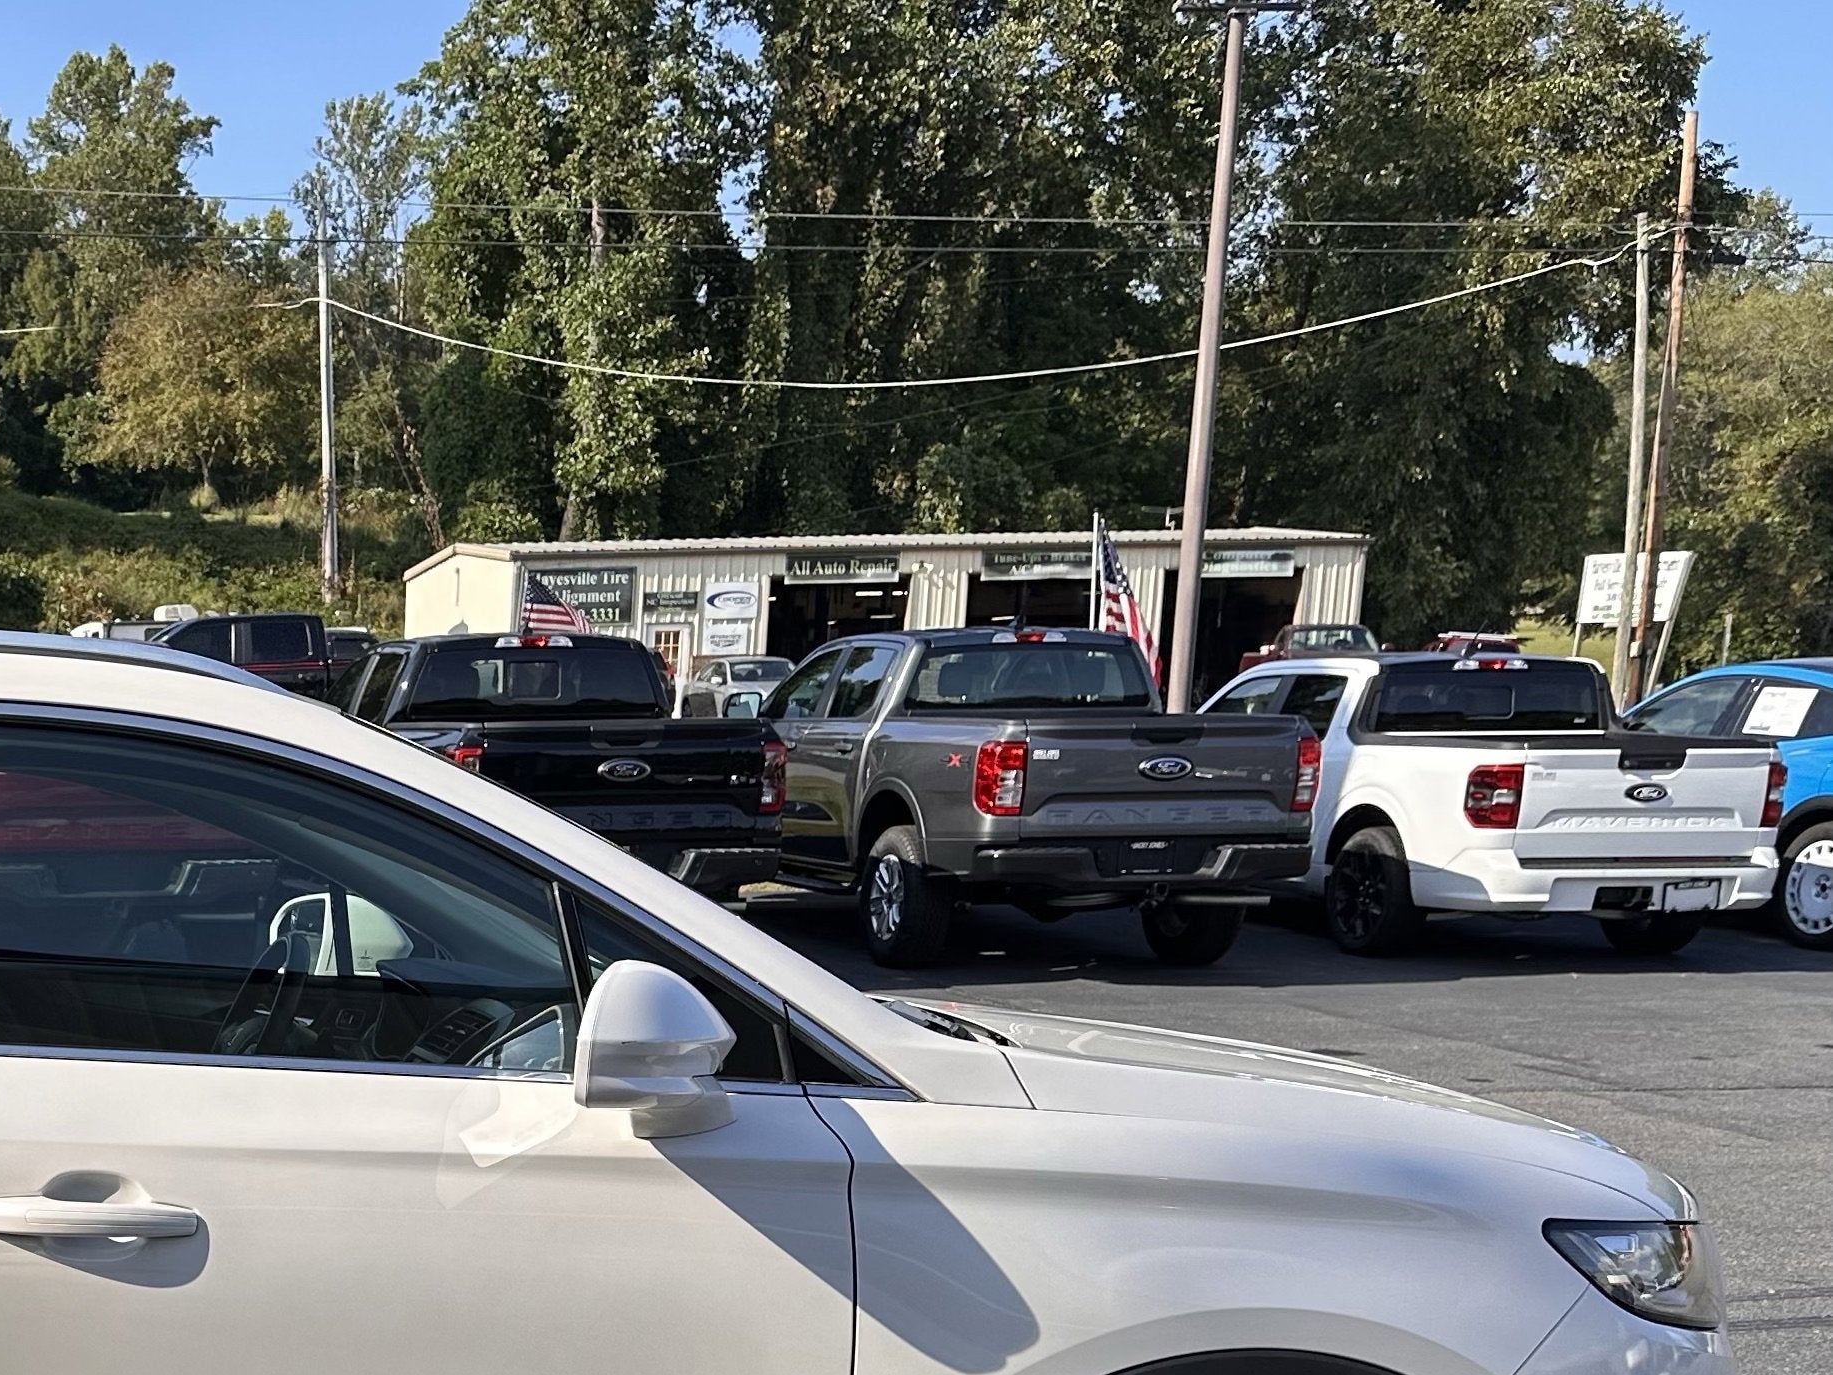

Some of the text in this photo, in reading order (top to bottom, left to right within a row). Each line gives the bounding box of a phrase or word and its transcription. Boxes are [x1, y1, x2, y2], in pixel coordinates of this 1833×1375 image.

[790, 558, 896, 578] All Auto Repair
[599, 570, 630, 586] Tire
[555, 589, 621, 606] lignment
[6, 824, 195, 841] RANGE
